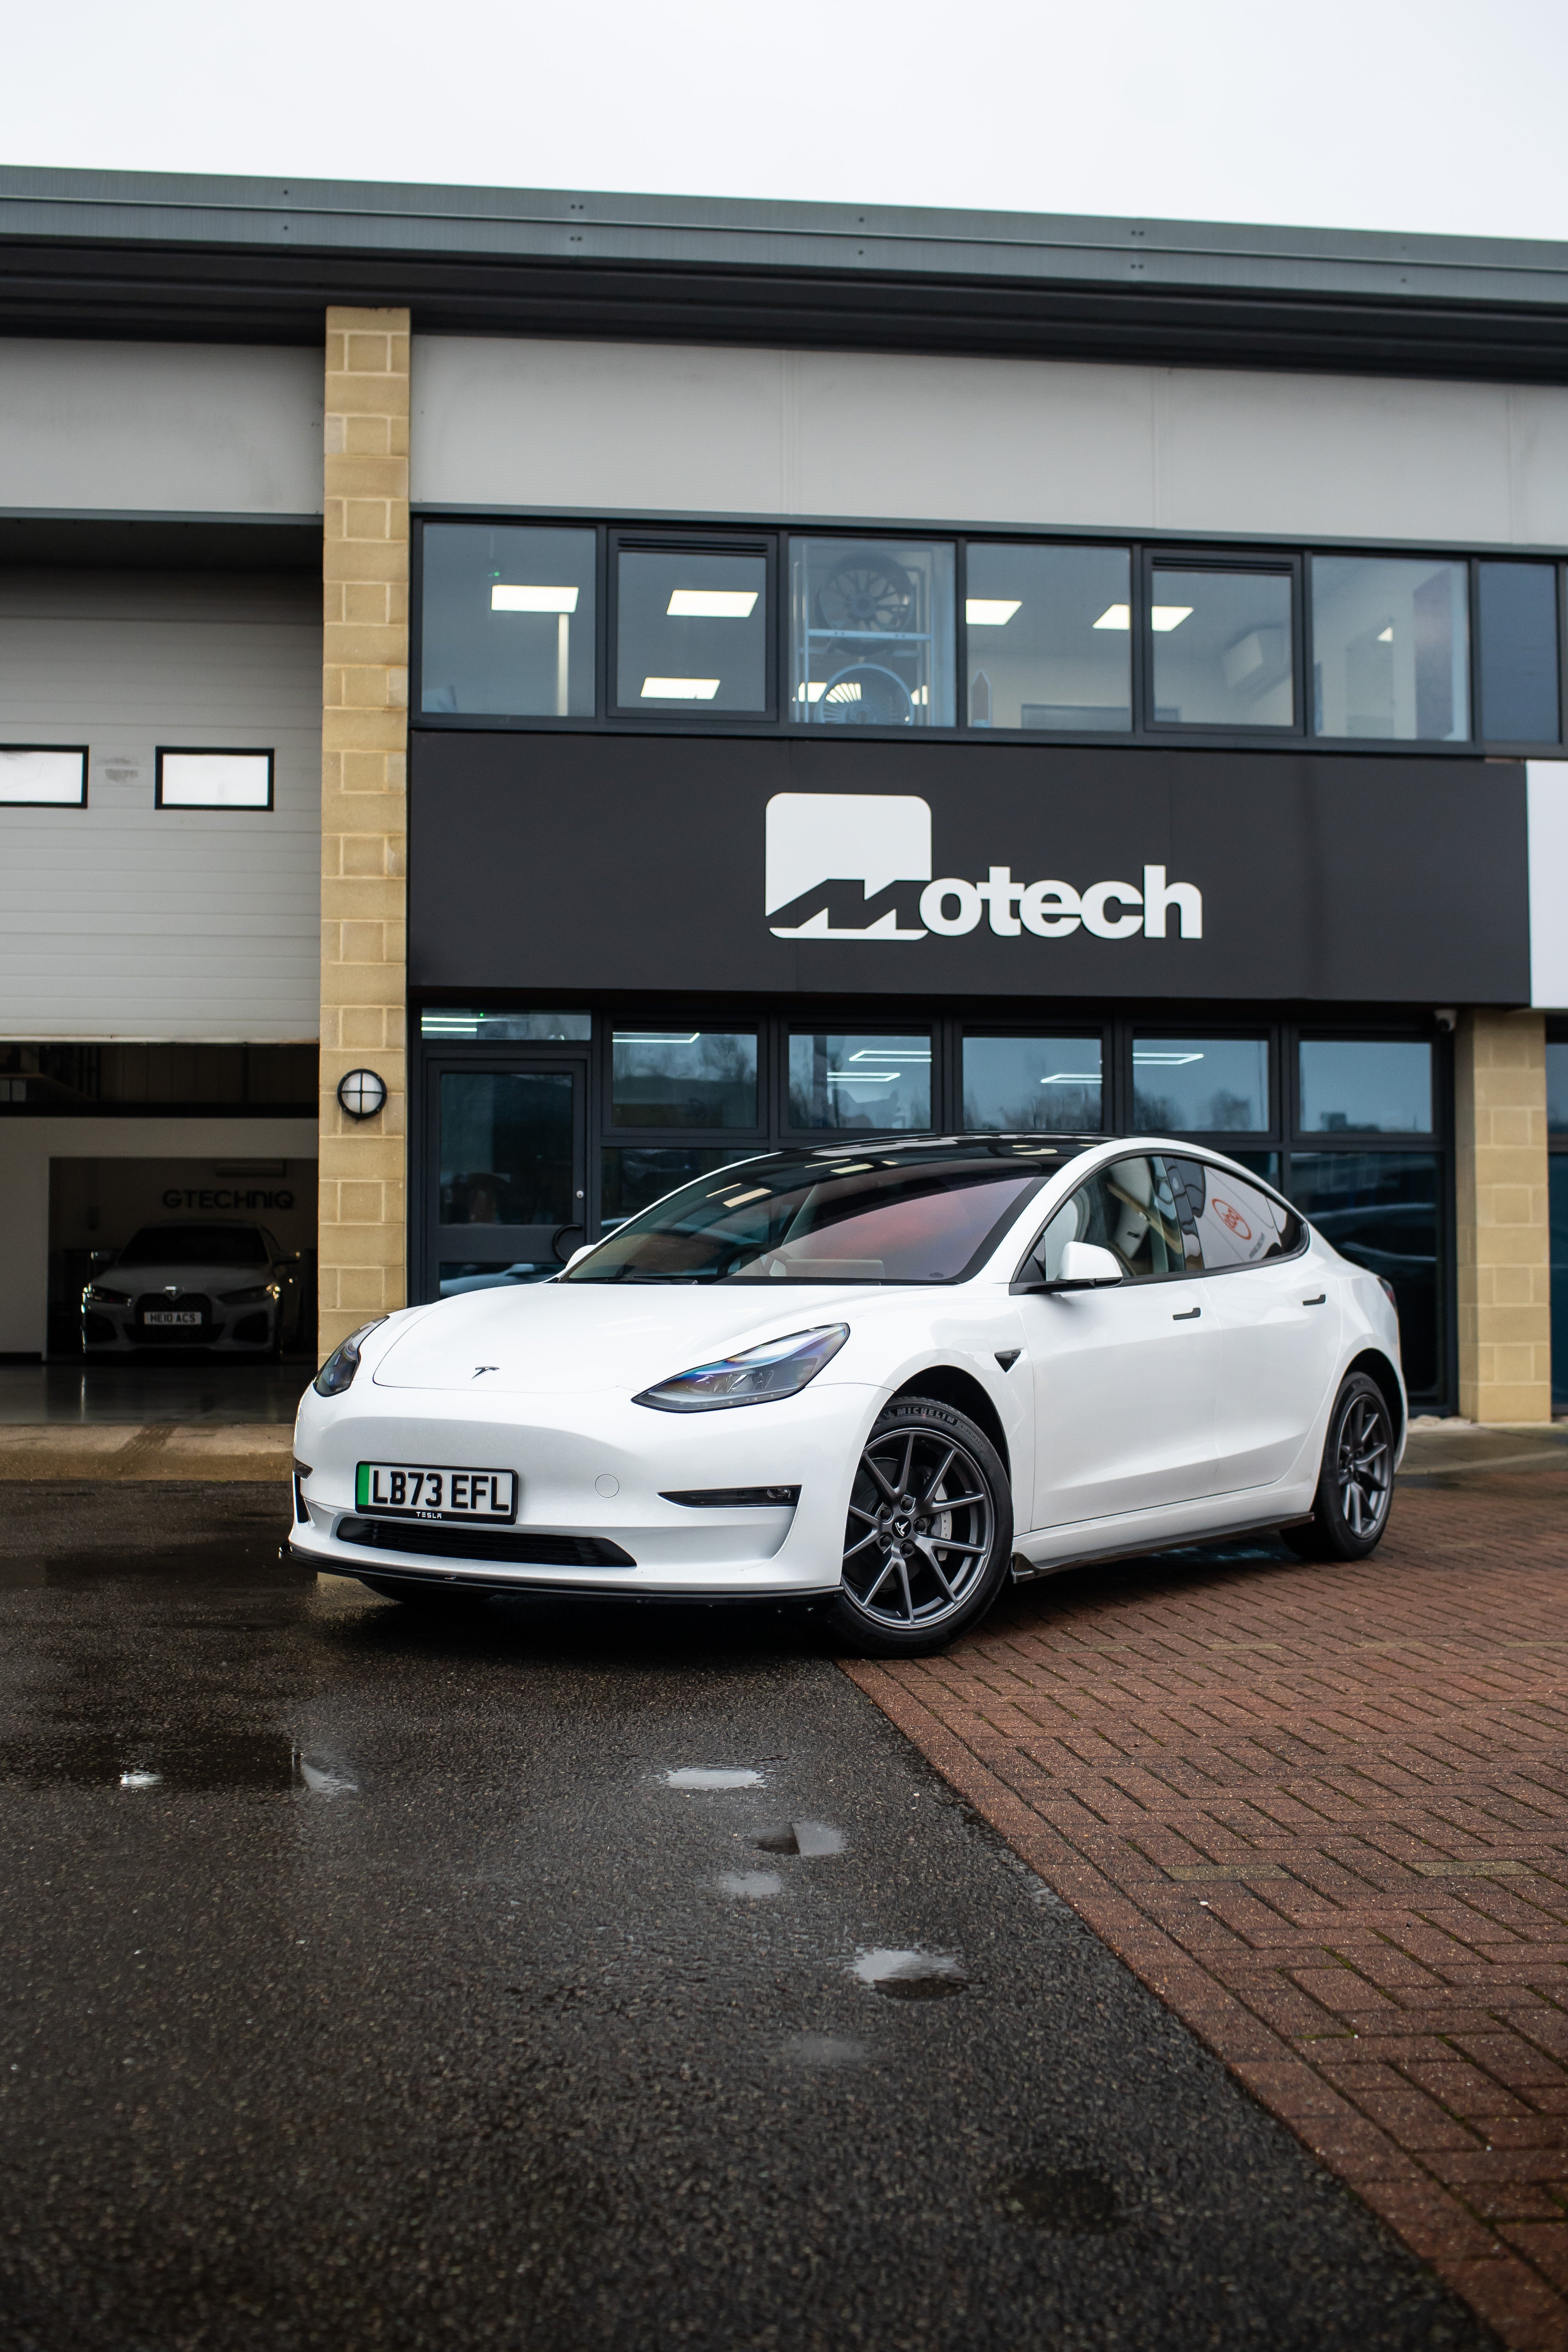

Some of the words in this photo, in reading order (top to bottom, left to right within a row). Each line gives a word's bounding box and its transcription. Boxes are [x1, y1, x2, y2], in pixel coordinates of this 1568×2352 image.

[765, 792, 1202, 940] Motech
[897, 1407, 955, 1424] MICHELIN
[372, 1470, 443, 1507] LB73
[450, 1474, 509, 1511] EFL
[416, 1511, 442, 1519] TESLA
